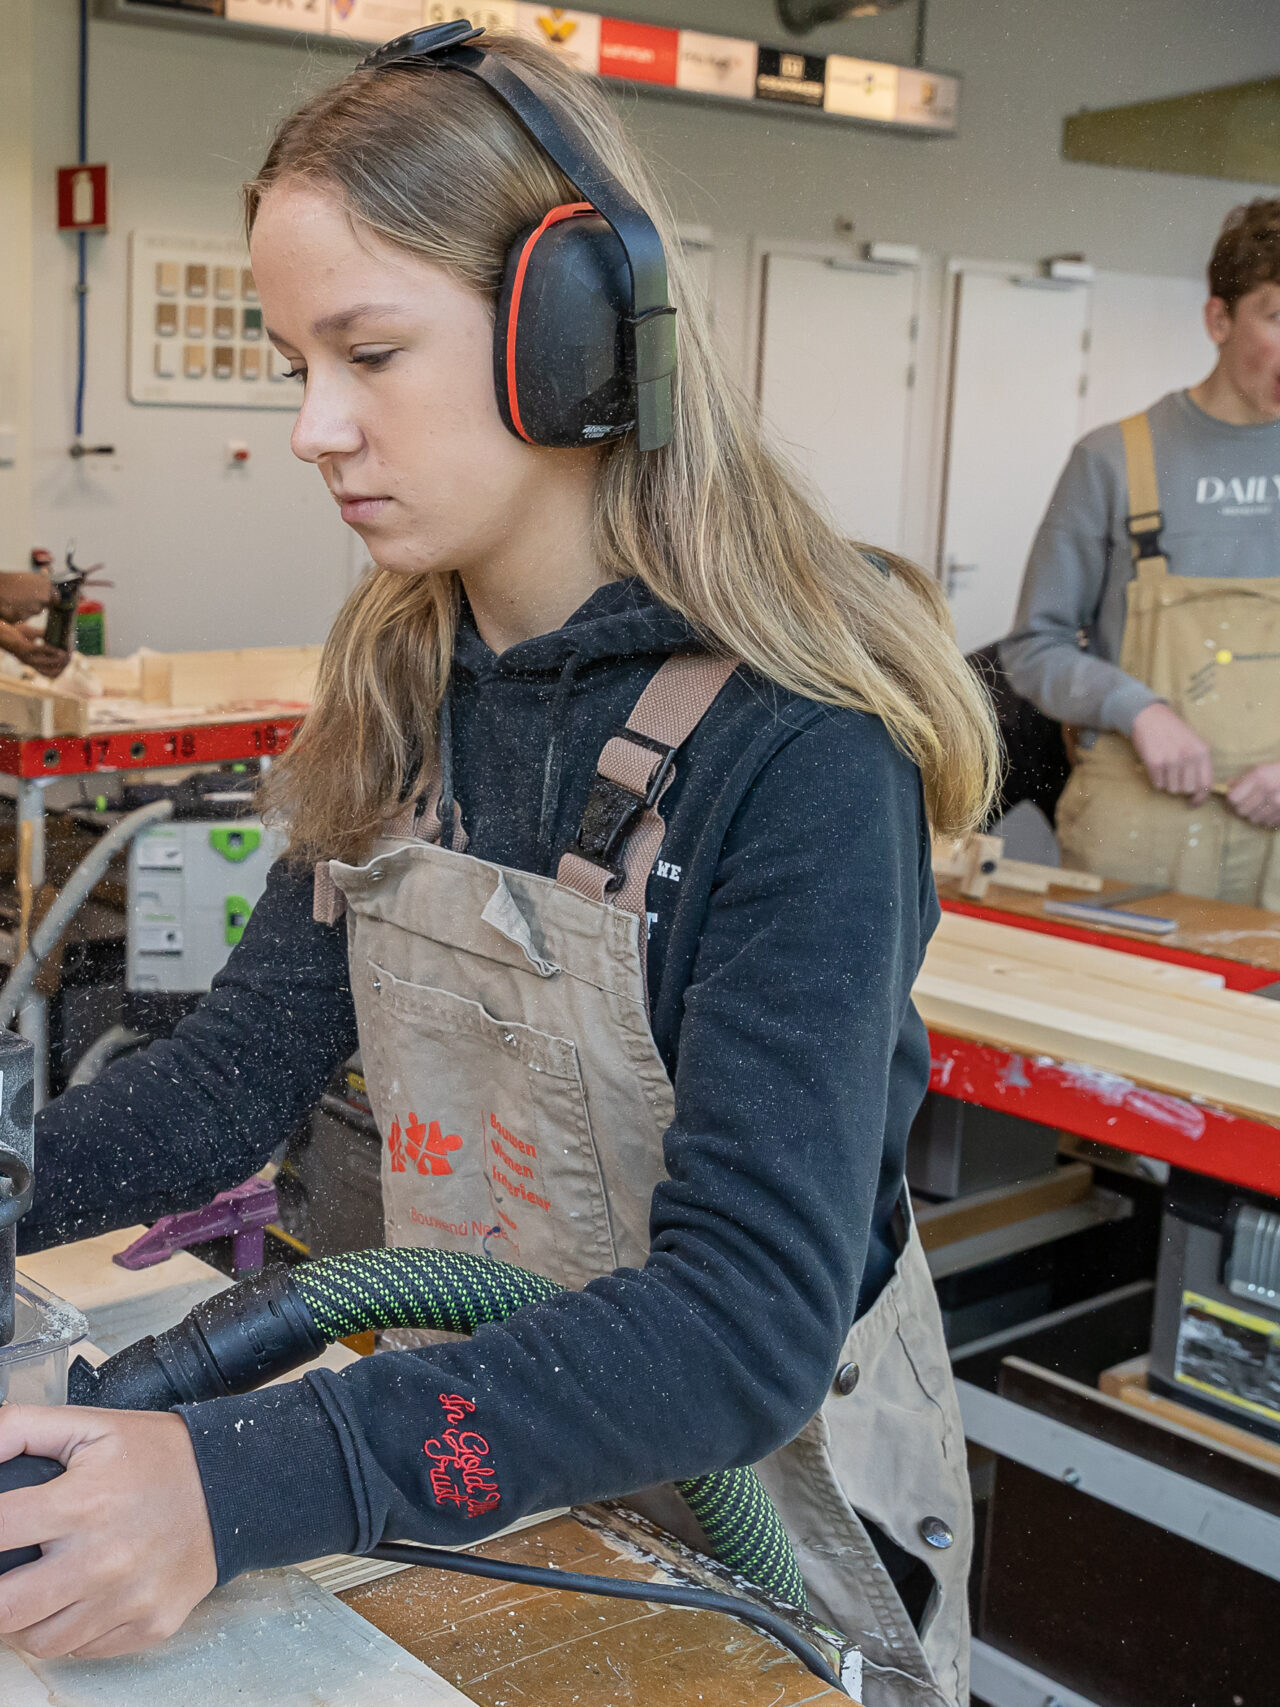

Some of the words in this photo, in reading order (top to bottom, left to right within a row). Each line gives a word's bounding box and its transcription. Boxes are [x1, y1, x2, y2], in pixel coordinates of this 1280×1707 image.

[83, 738, 111, 766] 17
[489, 1112, 537, 1159] Bouwen
[410, 1205, 469, 1237] Bouwend
[438, 1393, 476, 1425] In
[424, 1439, 469, 1509] Trust
[441, 1428, 498, 1494] Gold
